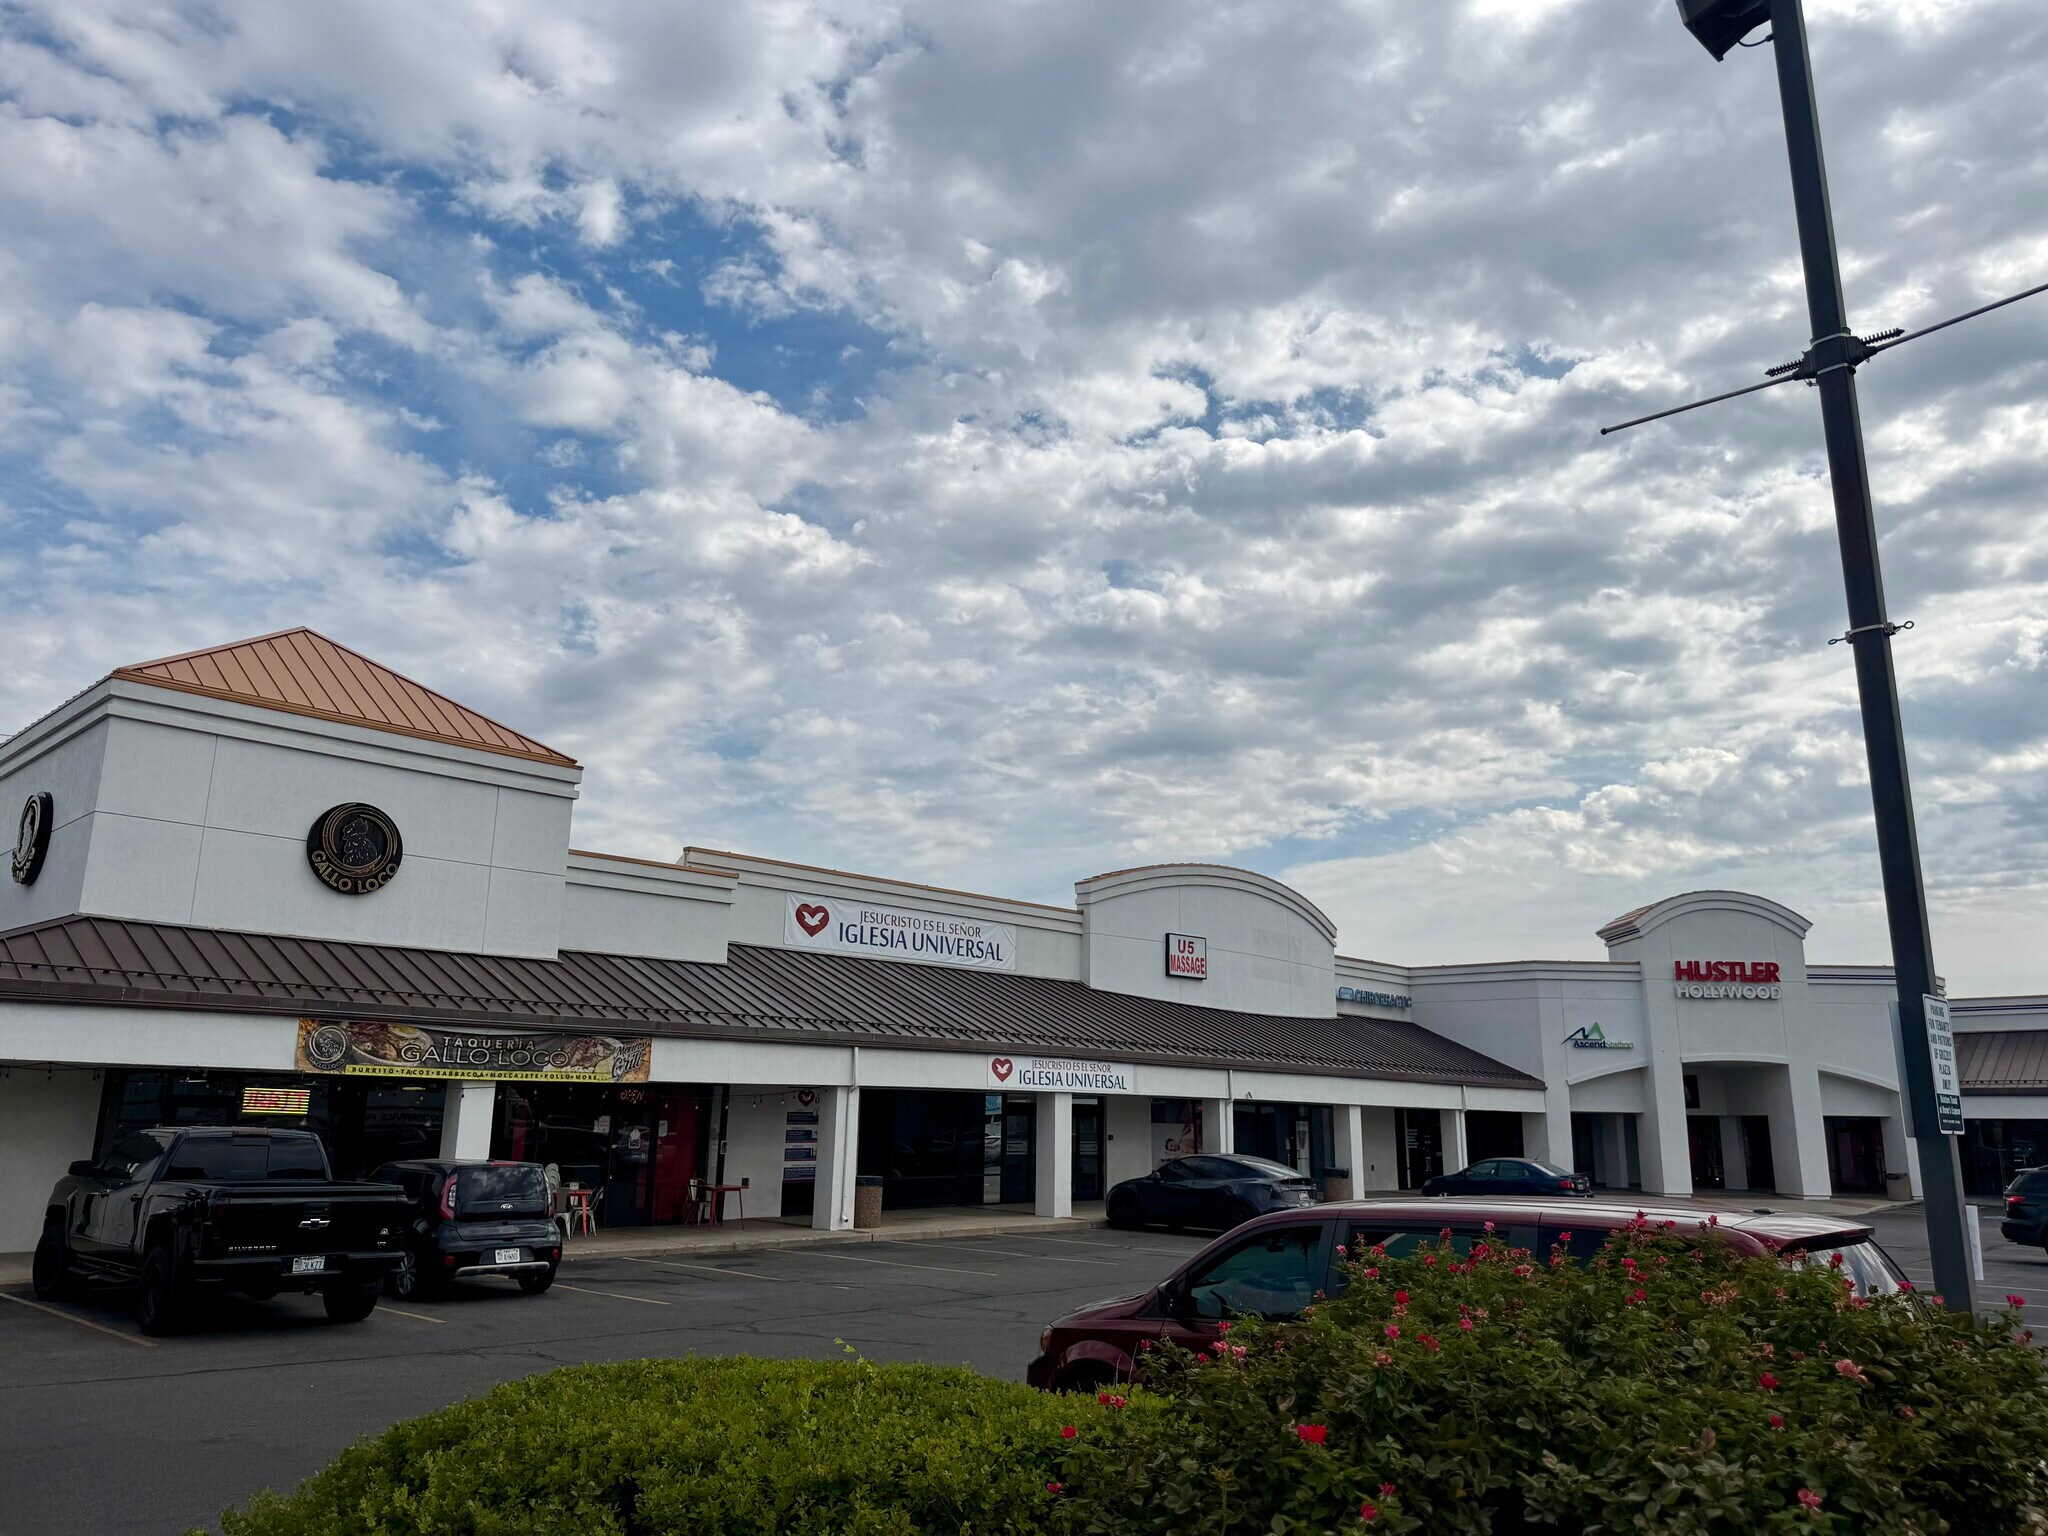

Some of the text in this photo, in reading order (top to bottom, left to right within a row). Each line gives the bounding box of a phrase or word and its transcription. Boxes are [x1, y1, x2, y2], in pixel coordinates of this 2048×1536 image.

[311, 850, 398, 893] GALLO LOCO
[859, 910, 982, 939] JESUCRISTO ES EL SEÑOR
[838, 922, 1004, 962] IGLESIA UNIVERSAL
[1170, 953, 1205, 975] MASSAGE
[1674, 960, 1781, 982] HUSTLER
[1355, 988, 1413, 1009] CHIROPRACTIC
[1676, 985, 1782, 1000] HOLLYWOOD
[1930, 1004, 1945, 1018] PARKING
[1928, 1018, 1950, 1033] FOR TENANTS
[1930, 1033, 1952, 1047] AND PATRONS
[401, 1044, 569, 1067] GALLO LOCO
[1934, 1047, 1939, 1059] OF
[352, 1066, 394, 1074] BURRITO
[612, 1051, 642, 1078] Grill
[1031, 1059, 1072, 1071] JESUCRISTO
[1072, 1062, 1081, 1072] ES
[1081, 1062, 1089, 1072] EL
[1019, 1069, 1127, 1090] IGLESIA UNIVERSAL
